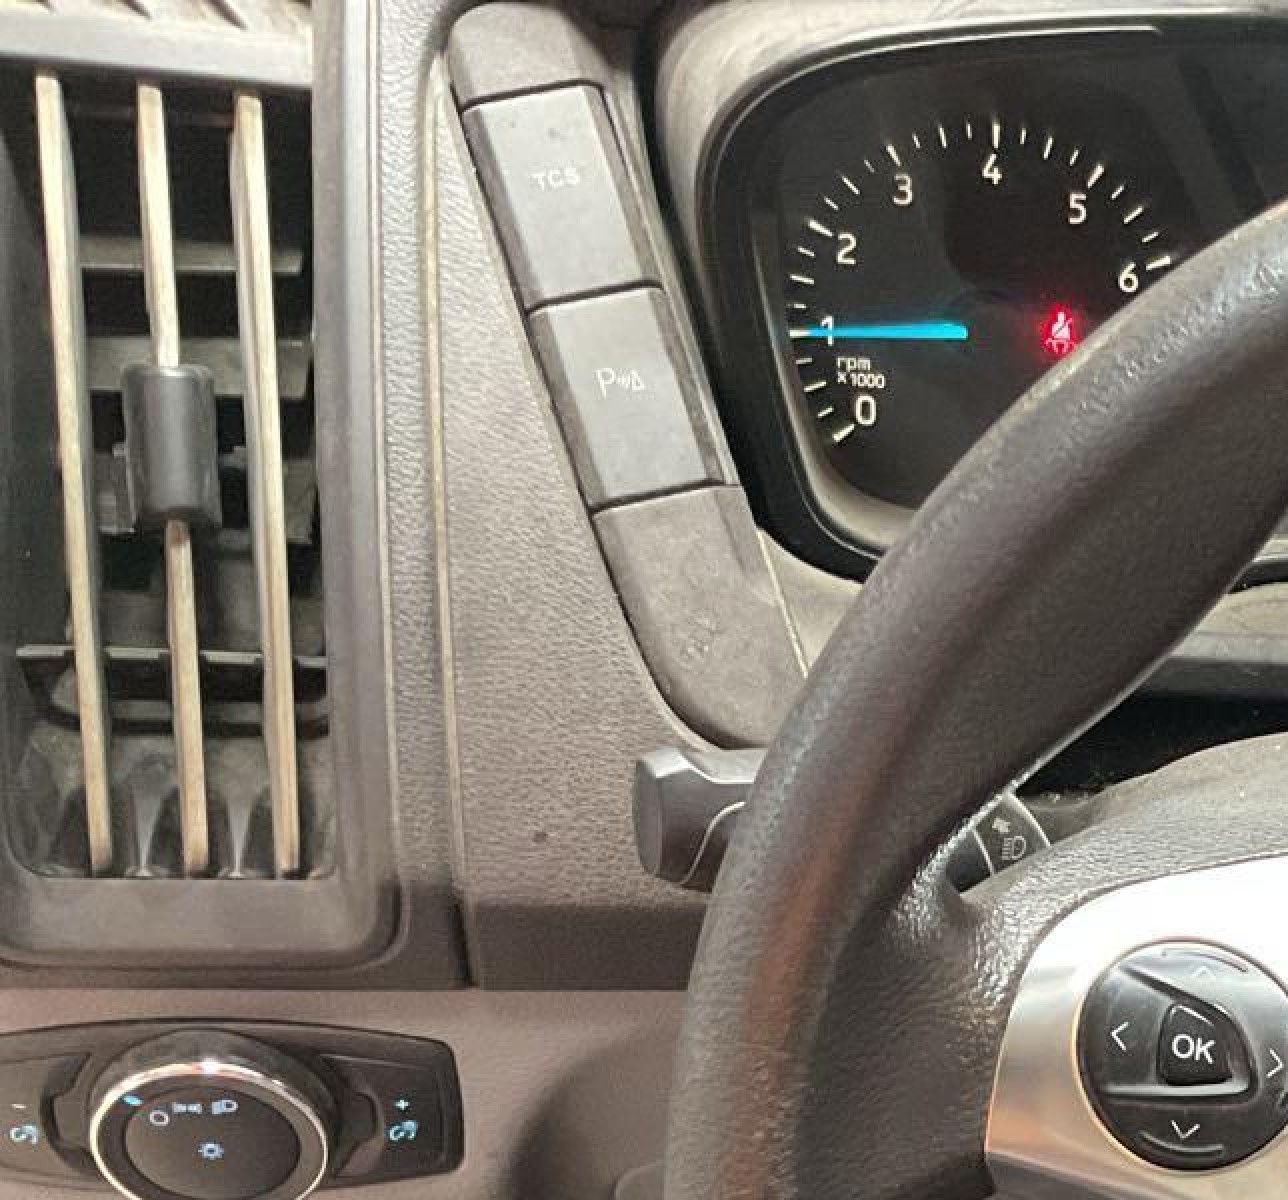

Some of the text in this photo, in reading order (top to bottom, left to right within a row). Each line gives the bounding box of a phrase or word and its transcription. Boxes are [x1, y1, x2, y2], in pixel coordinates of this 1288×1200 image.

[533, 166, 579, 191] TCS
[982, 153, 1002, 185] 4
[893, 174, 913, 205] 3
[1068, 193, 1087, 225] 5
[837, 233, 857, 265] 2
[1118, 261, 1139, 293] 6
[820, 315, 835, 346] 1
[836, 356, 871, 372] rpm
[855, 394, 877, 426] 0
[1171, 1033, 1216, 1065] OK
